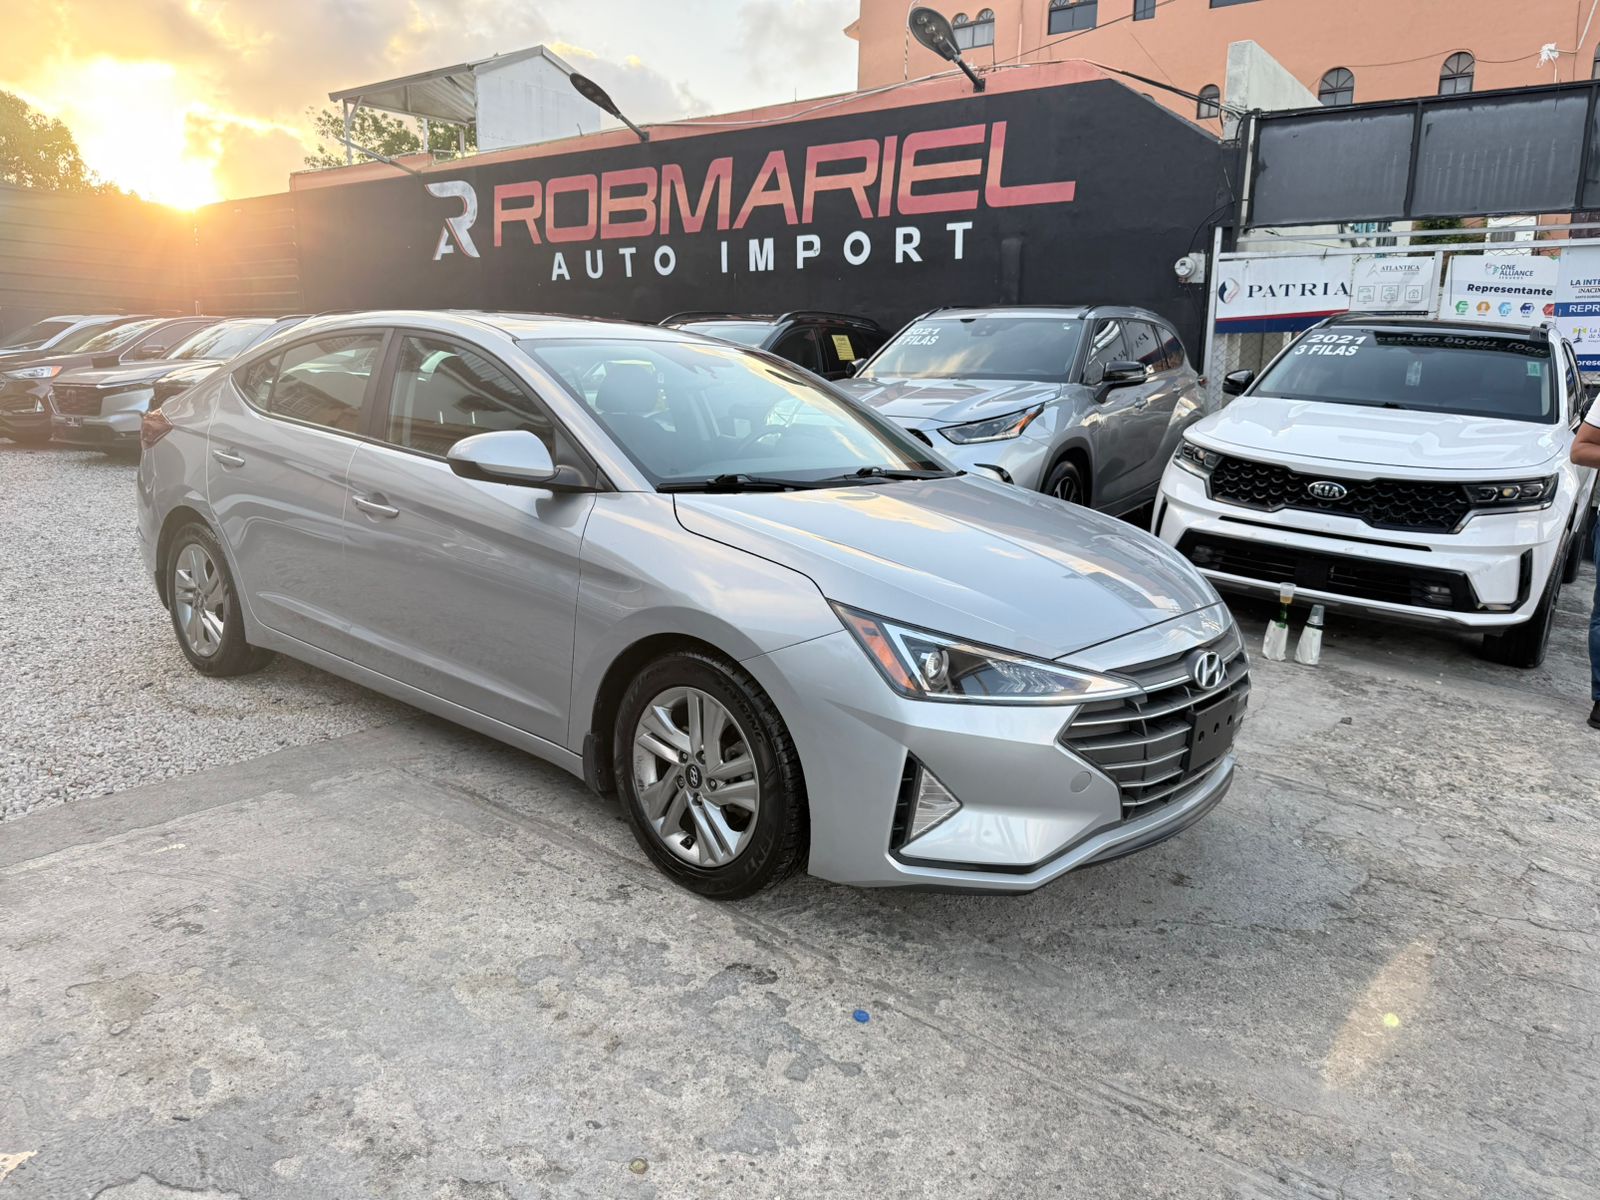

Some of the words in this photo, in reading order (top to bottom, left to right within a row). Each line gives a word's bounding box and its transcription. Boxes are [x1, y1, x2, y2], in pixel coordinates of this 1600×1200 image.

[494, 121, 1076, 247] ROBMARIEL
[551, 245, 676, 281] AUTO
[721, 221, 973, 273] IMPORT
[1247, 281, 1349, 298] PATRIA
[1467, 283, 1553, 296] Representante
[1569, 304, 1600, 312] REPR
[904, 327, 941, 335] 2021
[902, 335, 939, 345] FILAS
[1306, 334, 1367, 344] 2021
[1294, 344, 1308, 355] 3
[1307, 344, 1359, 356] FILAS
[1313, 484, 1340, 498] KIA
